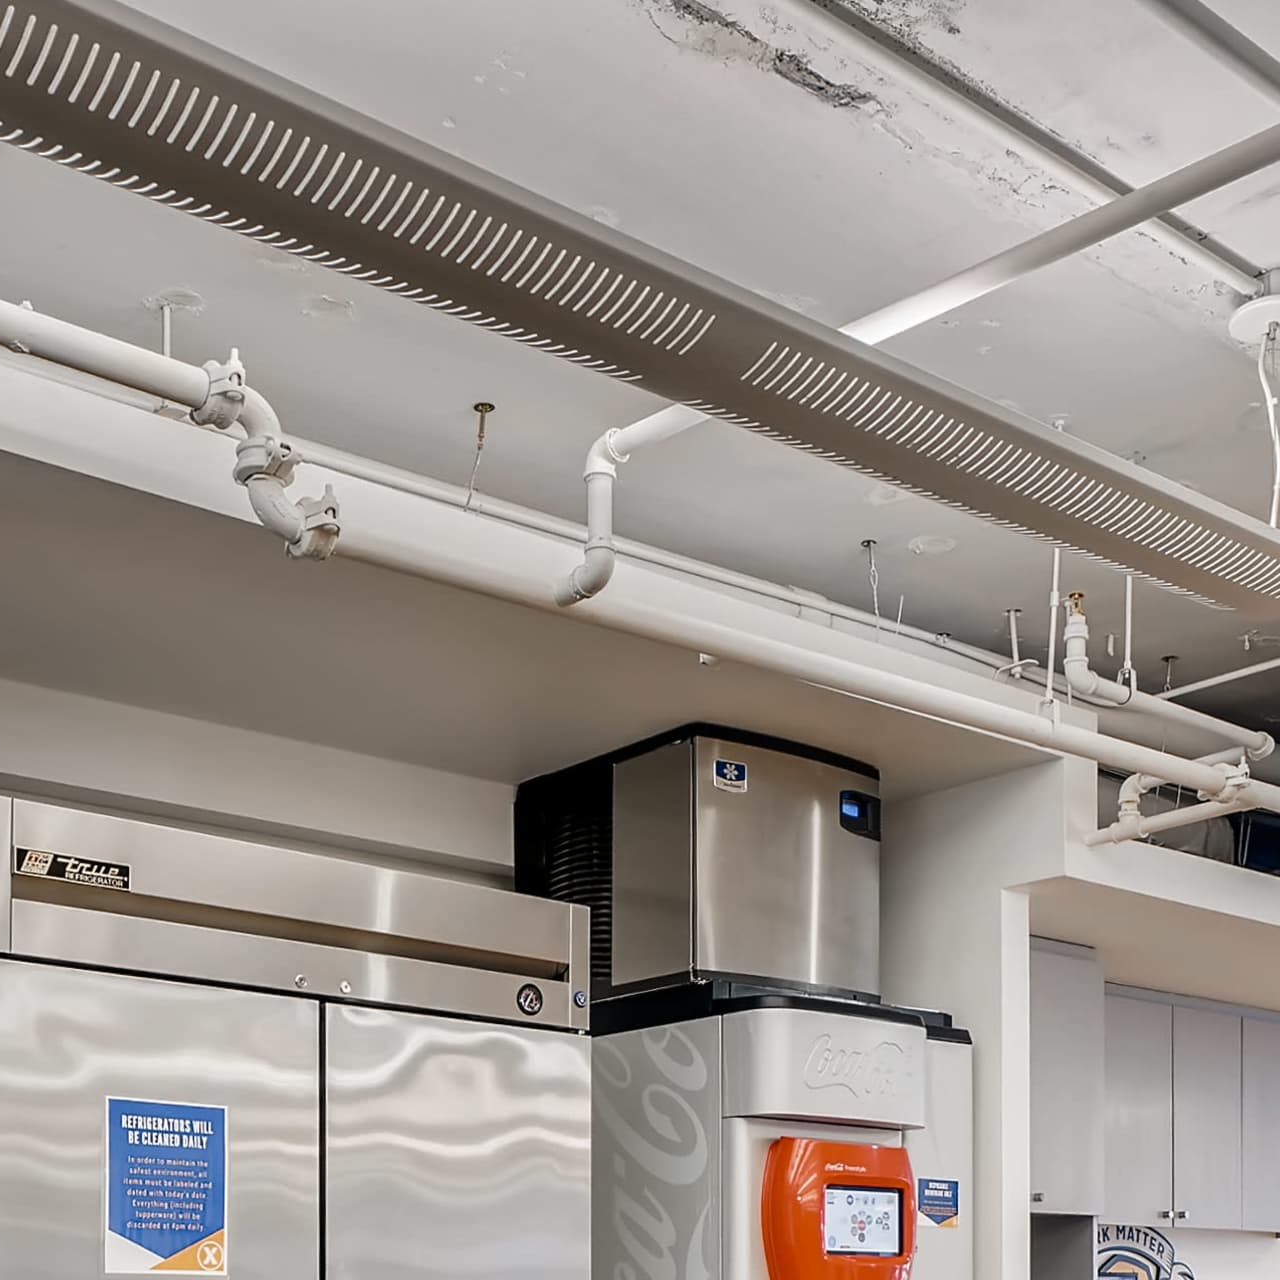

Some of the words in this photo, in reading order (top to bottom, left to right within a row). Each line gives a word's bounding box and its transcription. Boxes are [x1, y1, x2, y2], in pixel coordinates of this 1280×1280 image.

[65, 871, 124, 889] REFRIGERATOR
[121, 1114, 191, 1133] REFRIGERATORS
[192, 1119, 214, 1135] WILL
[128, 1130, 140, 1145] BE
[141, 1131, 180, 1148] CLEANED
[182, 1134, 208, 1150] DAILY
[136, 1156, 156, 1165] order
[157, 1158, 165, 1166] to
[166, 1159, 195, 1167] maintain
[197, 1160, 208, 1168] the
[129, 1167, 152, 1175] safest
[123, 1176, 143, 1185] items
[144, 1178, 162, 1187] must
[163, 1179, 172, 1187] be
[173, 1179, 198, 1188] labeled
[200, 1181, 213, 1190] and
[126, 1188, 147, 1197] dated
[148, 1189, 164, 1197] with
[132, 1199, 168, 1209] Everything
[178, 1212, 190, 1220] will
[126, 1221, 161, 1230] discarded
[162, 1222, 170, 1230] at
[1115, 1224, 1165, 1259] MATTER
